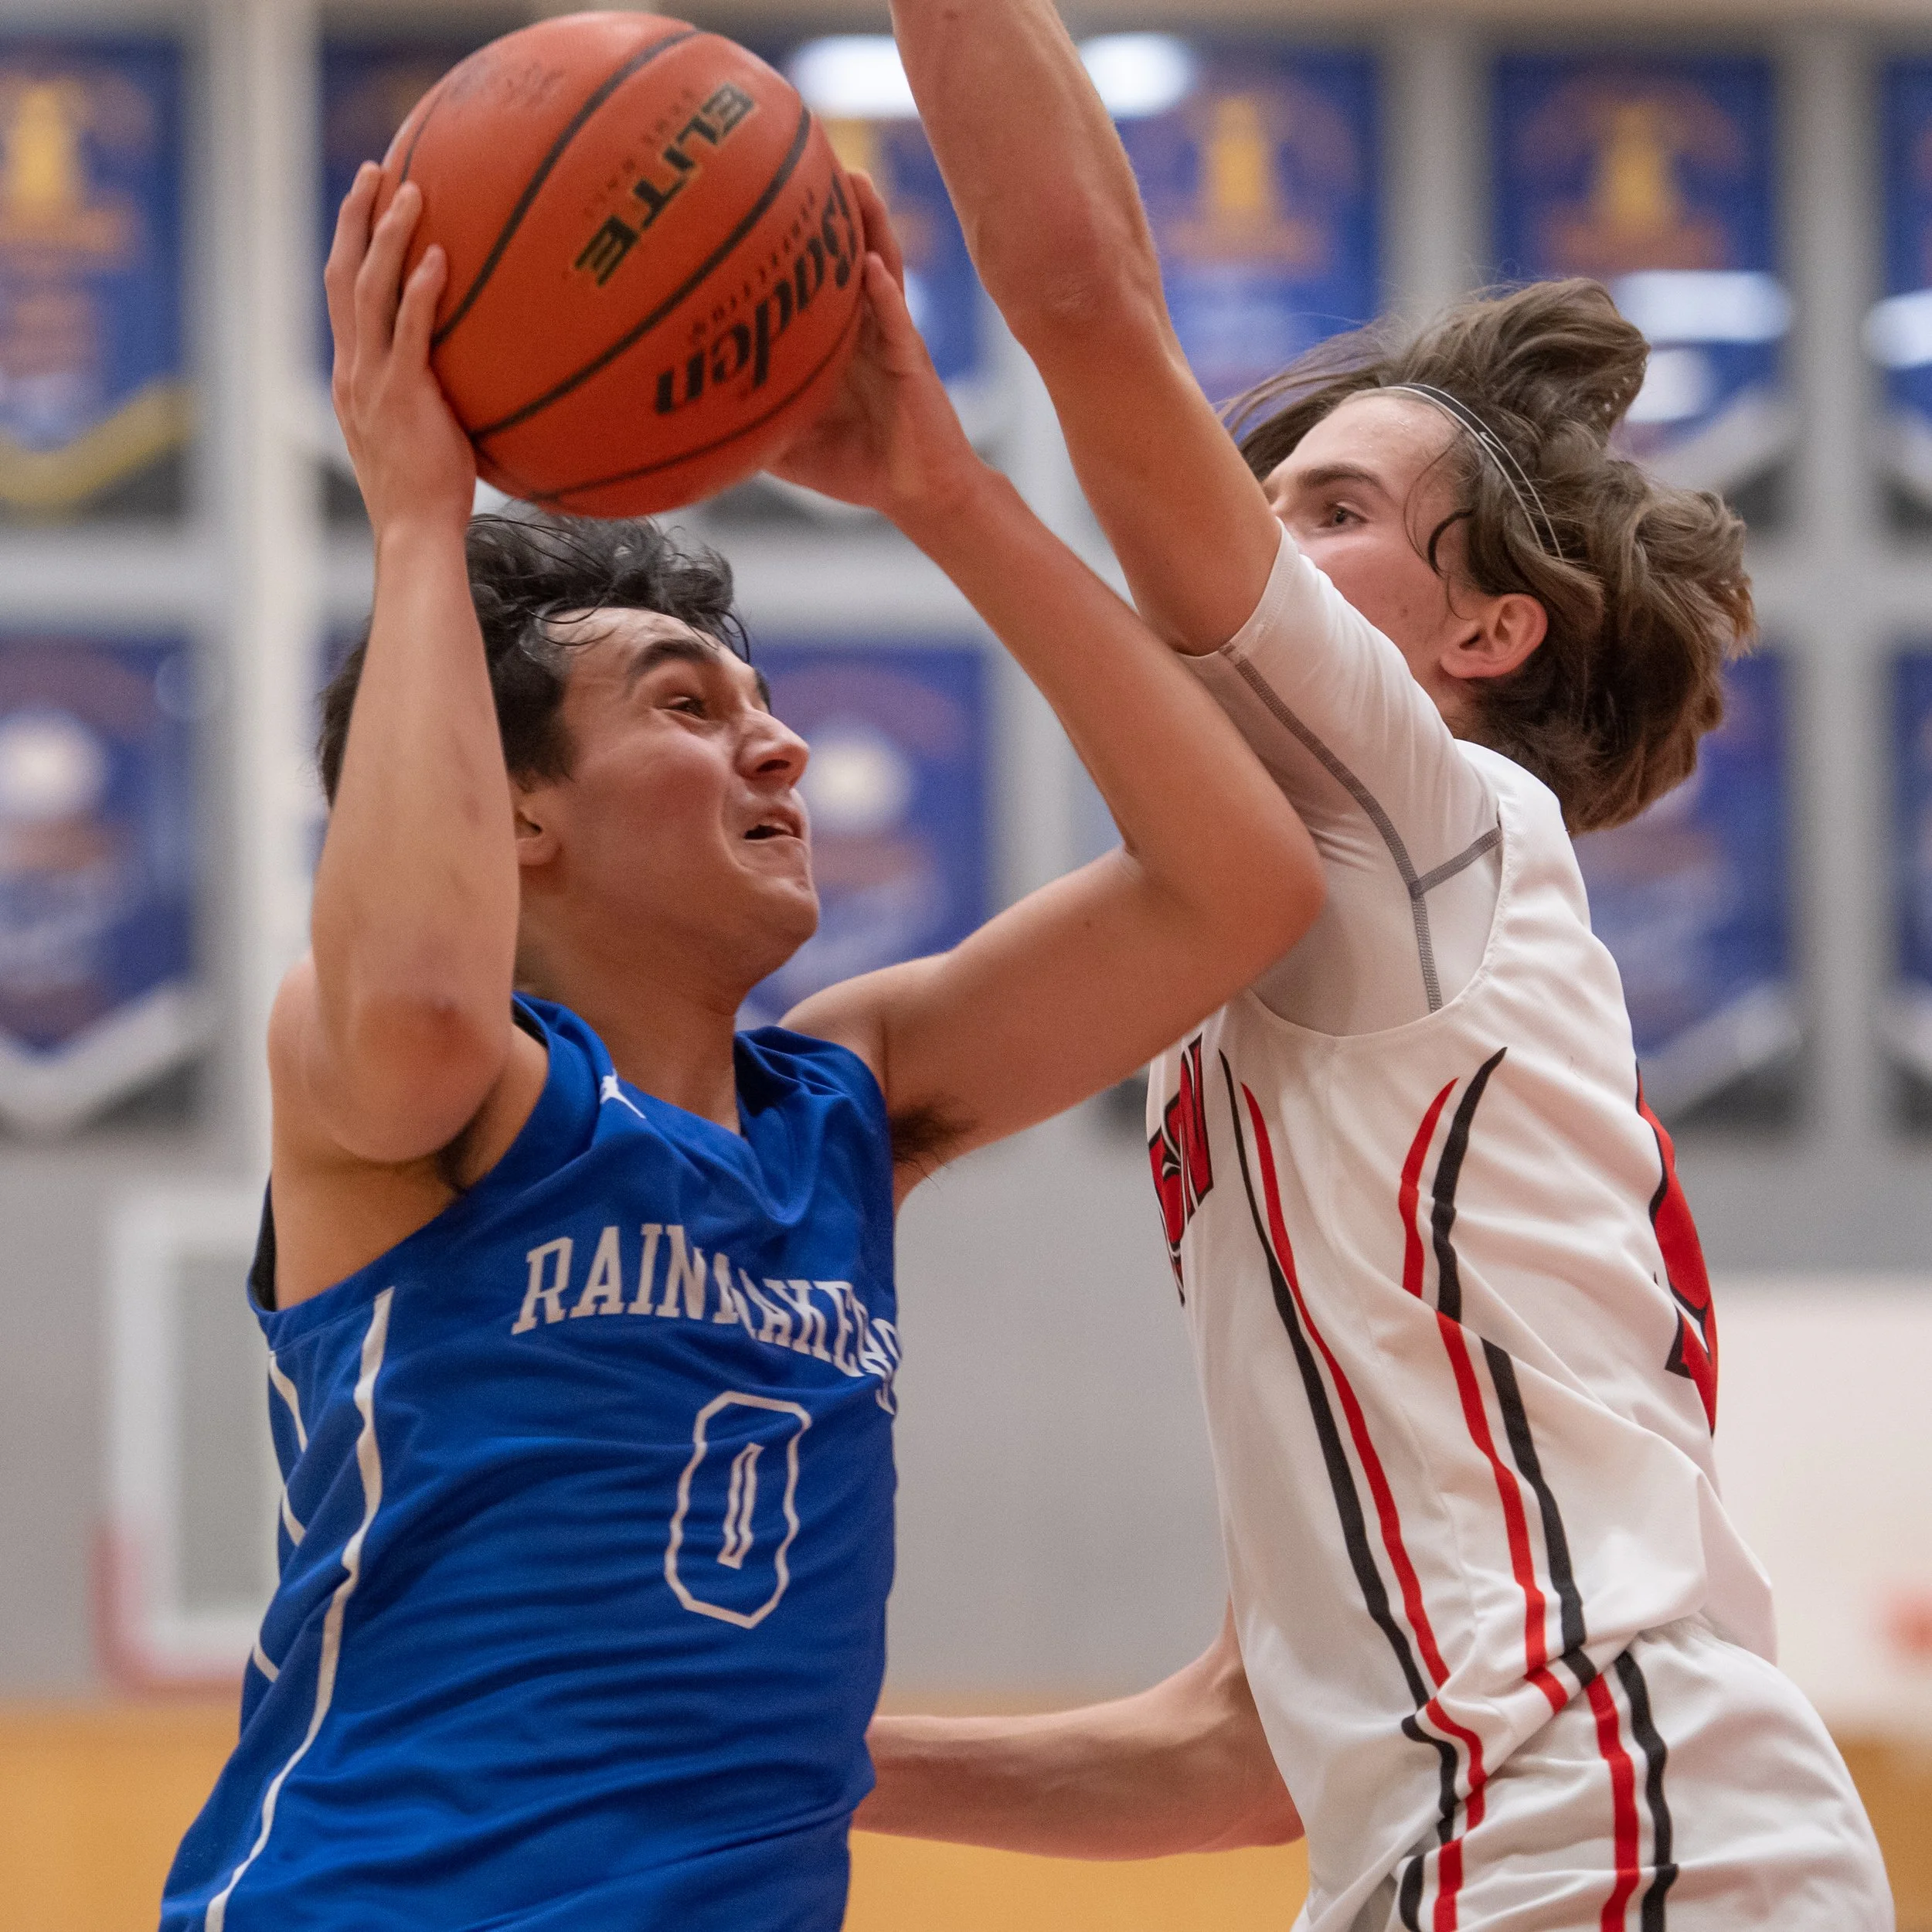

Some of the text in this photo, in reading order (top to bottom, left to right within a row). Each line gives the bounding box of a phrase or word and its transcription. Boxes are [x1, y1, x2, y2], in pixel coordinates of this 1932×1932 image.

[573, 82, 754, 287] ELITE
[655, 172, 858, 415] Baden
[664, 1390, 812, 1630] 0
